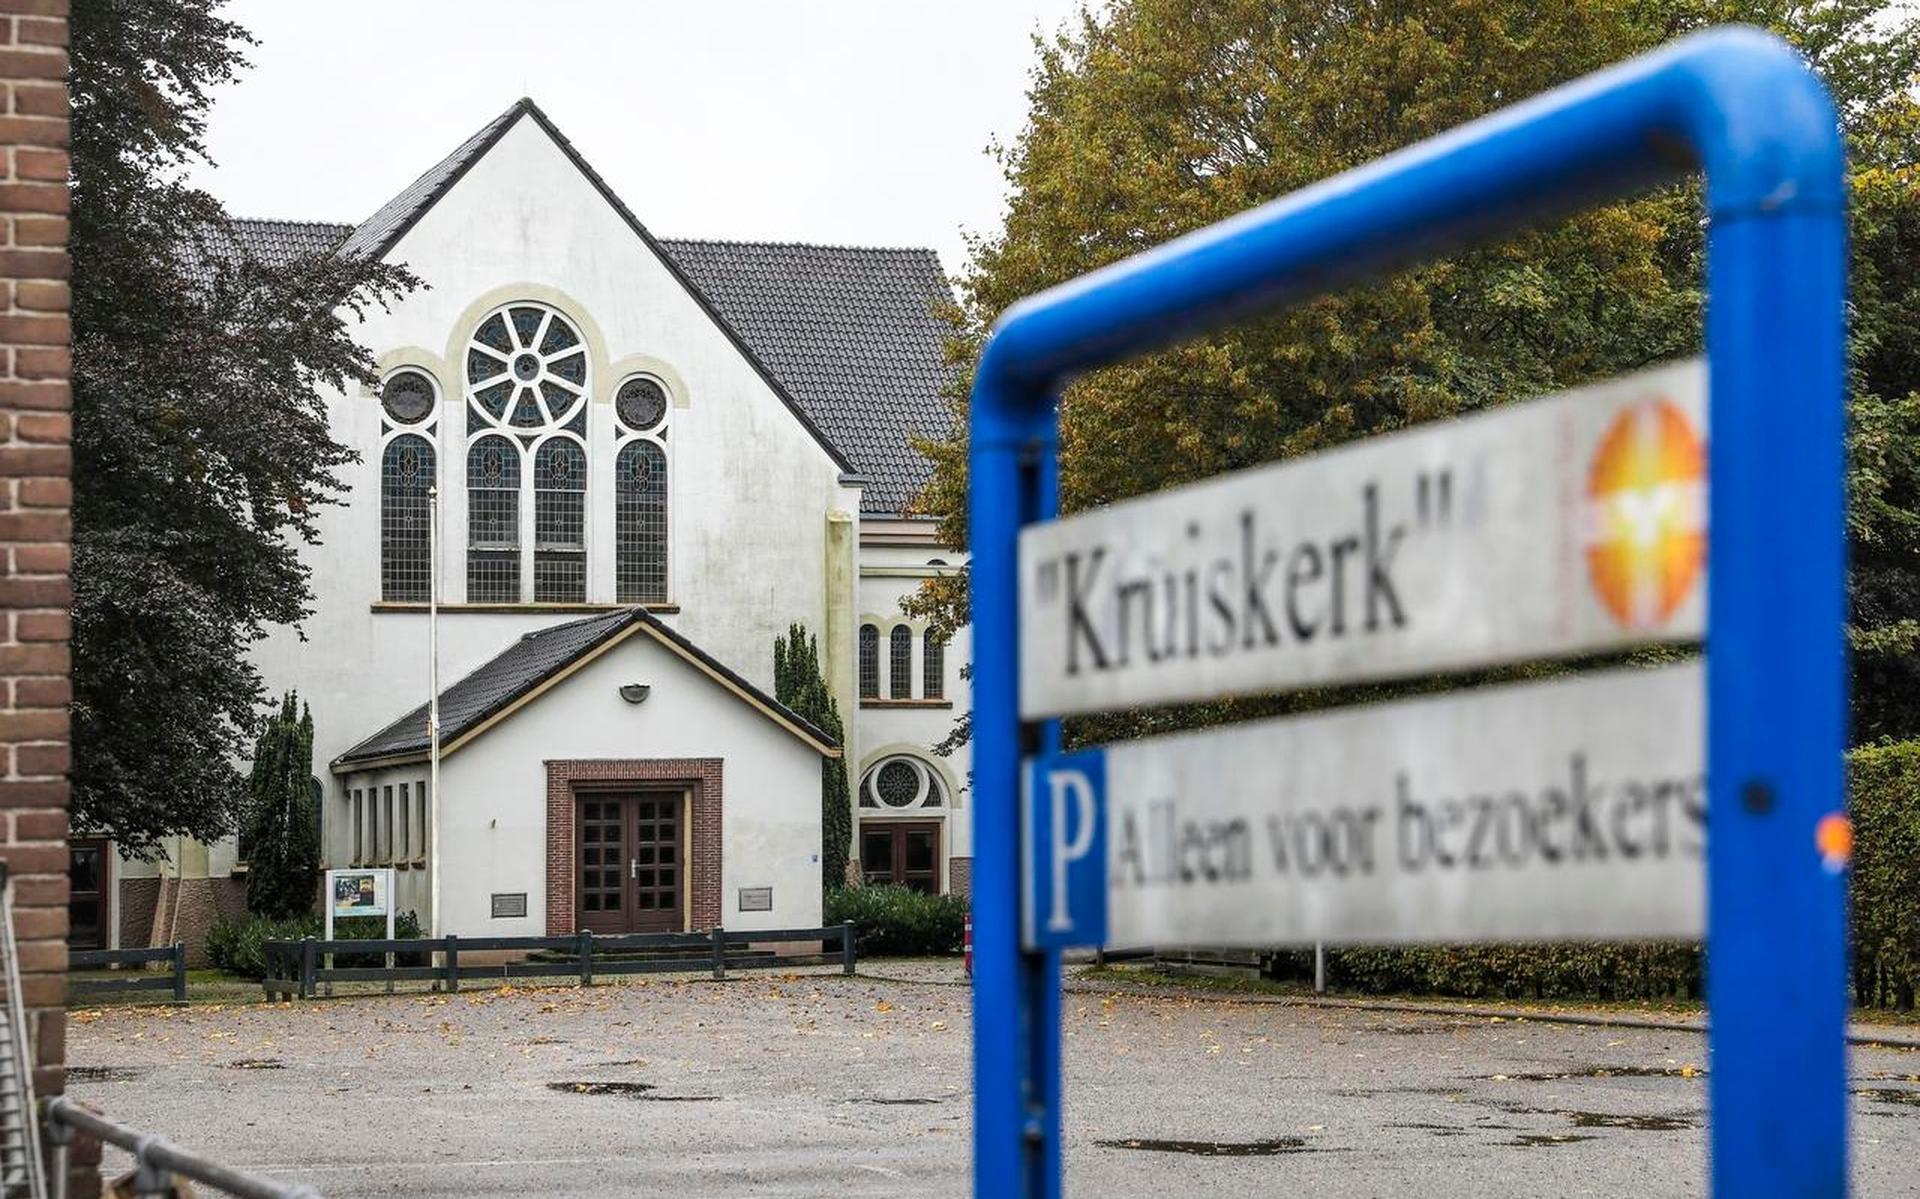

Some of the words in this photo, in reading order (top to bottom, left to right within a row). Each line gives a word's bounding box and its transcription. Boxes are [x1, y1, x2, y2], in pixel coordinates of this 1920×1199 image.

[1036, 466, 1454, 677] "Kruiskerk"
[1048, 770, 1096, 932] P
[1113, 799, 1252, 886] Alleen
[1266, 804, 1383, 878] voor
